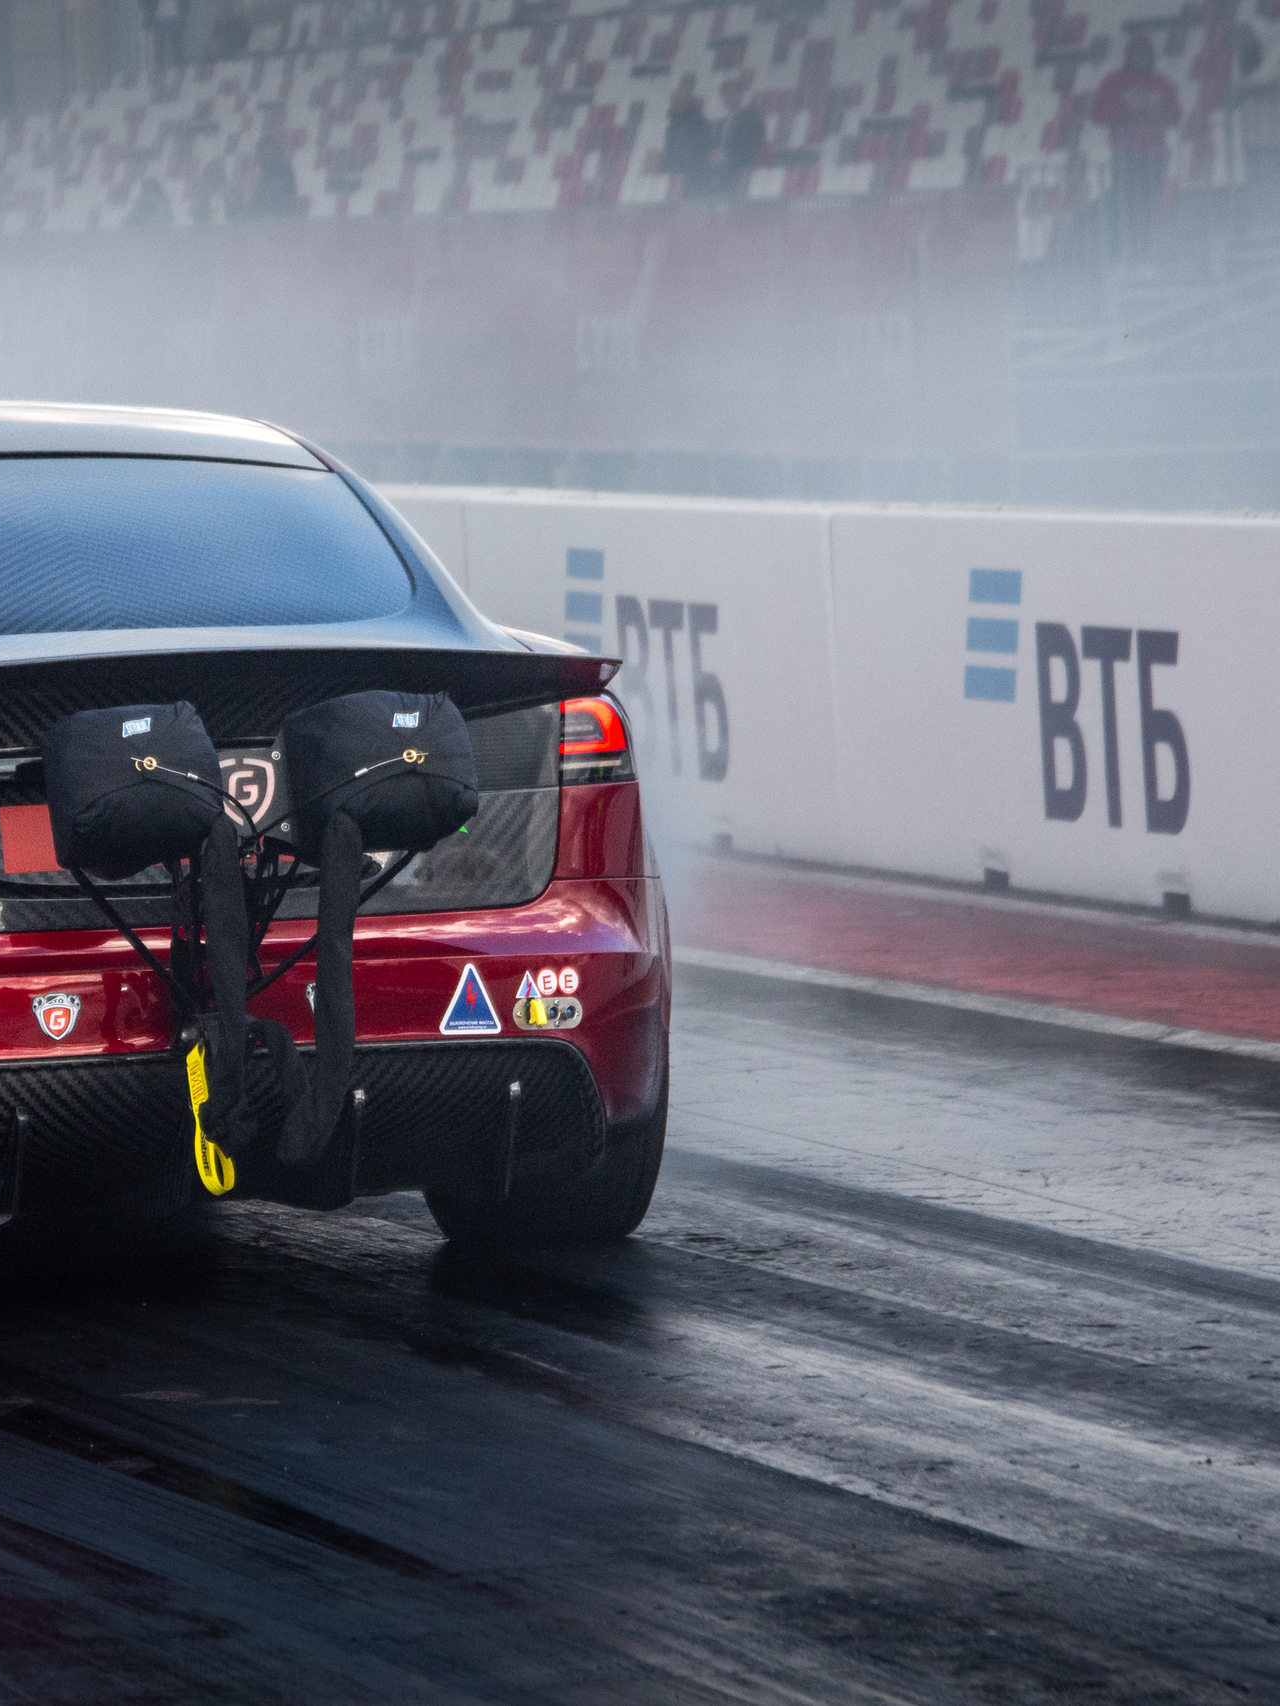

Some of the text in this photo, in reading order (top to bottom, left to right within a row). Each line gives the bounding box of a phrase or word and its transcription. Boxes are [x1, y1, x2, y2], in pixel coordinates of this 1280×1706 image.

[615, 595, 730, 783] ВТБ
[1034, 621, 1191, 835] ВТБ
[228, 770, 259, 806] G
[542, 974, 553, 990] E
[564, 974, 573, 989] E
[49, 1010, 66, 1031] G
